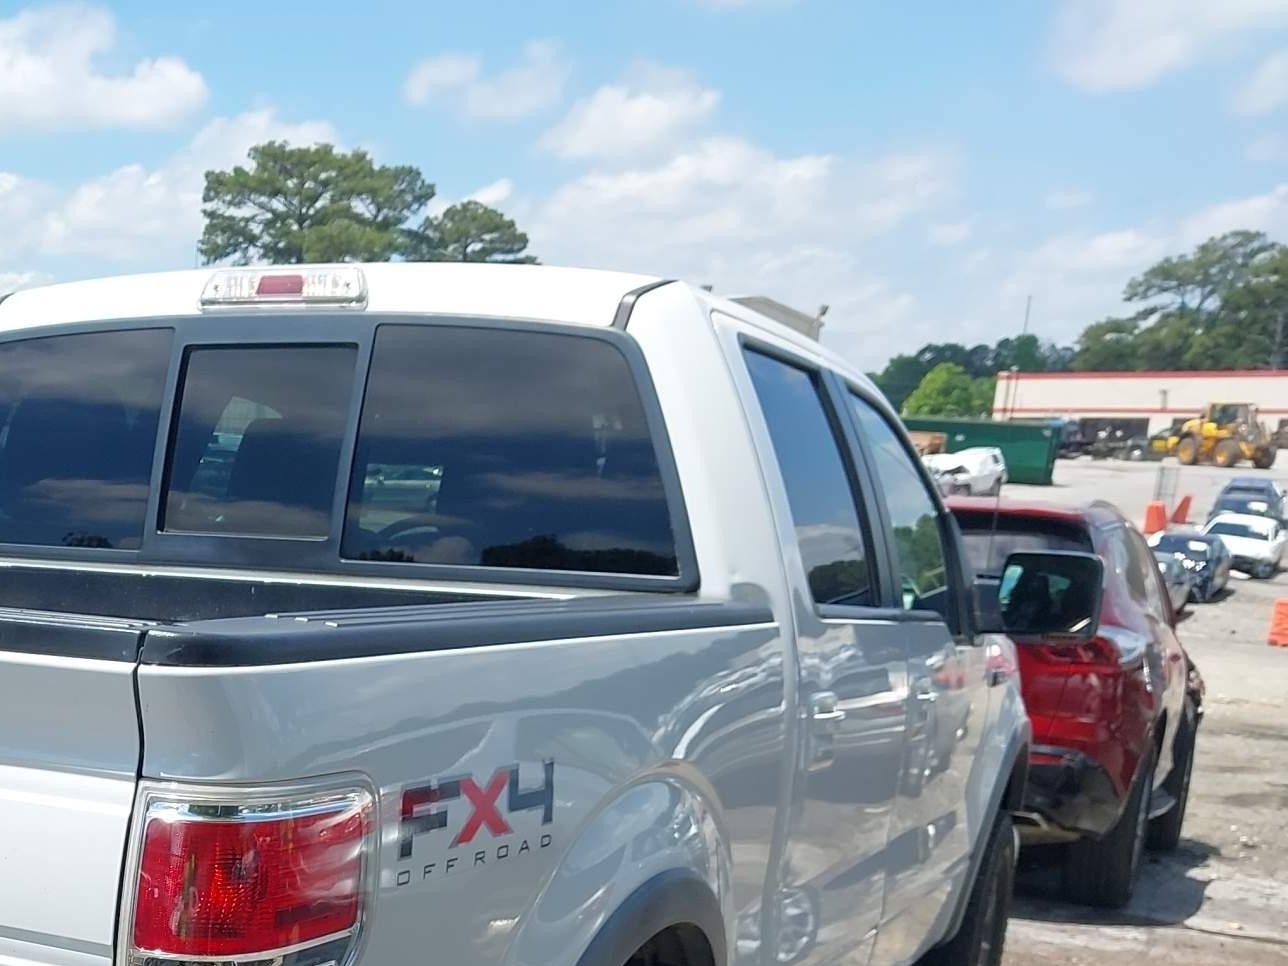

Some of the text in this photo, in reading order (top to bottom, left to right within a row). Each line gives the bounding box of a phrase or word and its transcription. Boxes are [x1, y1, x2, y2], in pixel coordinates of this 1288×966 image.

[399, 761, 554, 861] FX4
[397, 834, 552, 886] OFF ROAD
